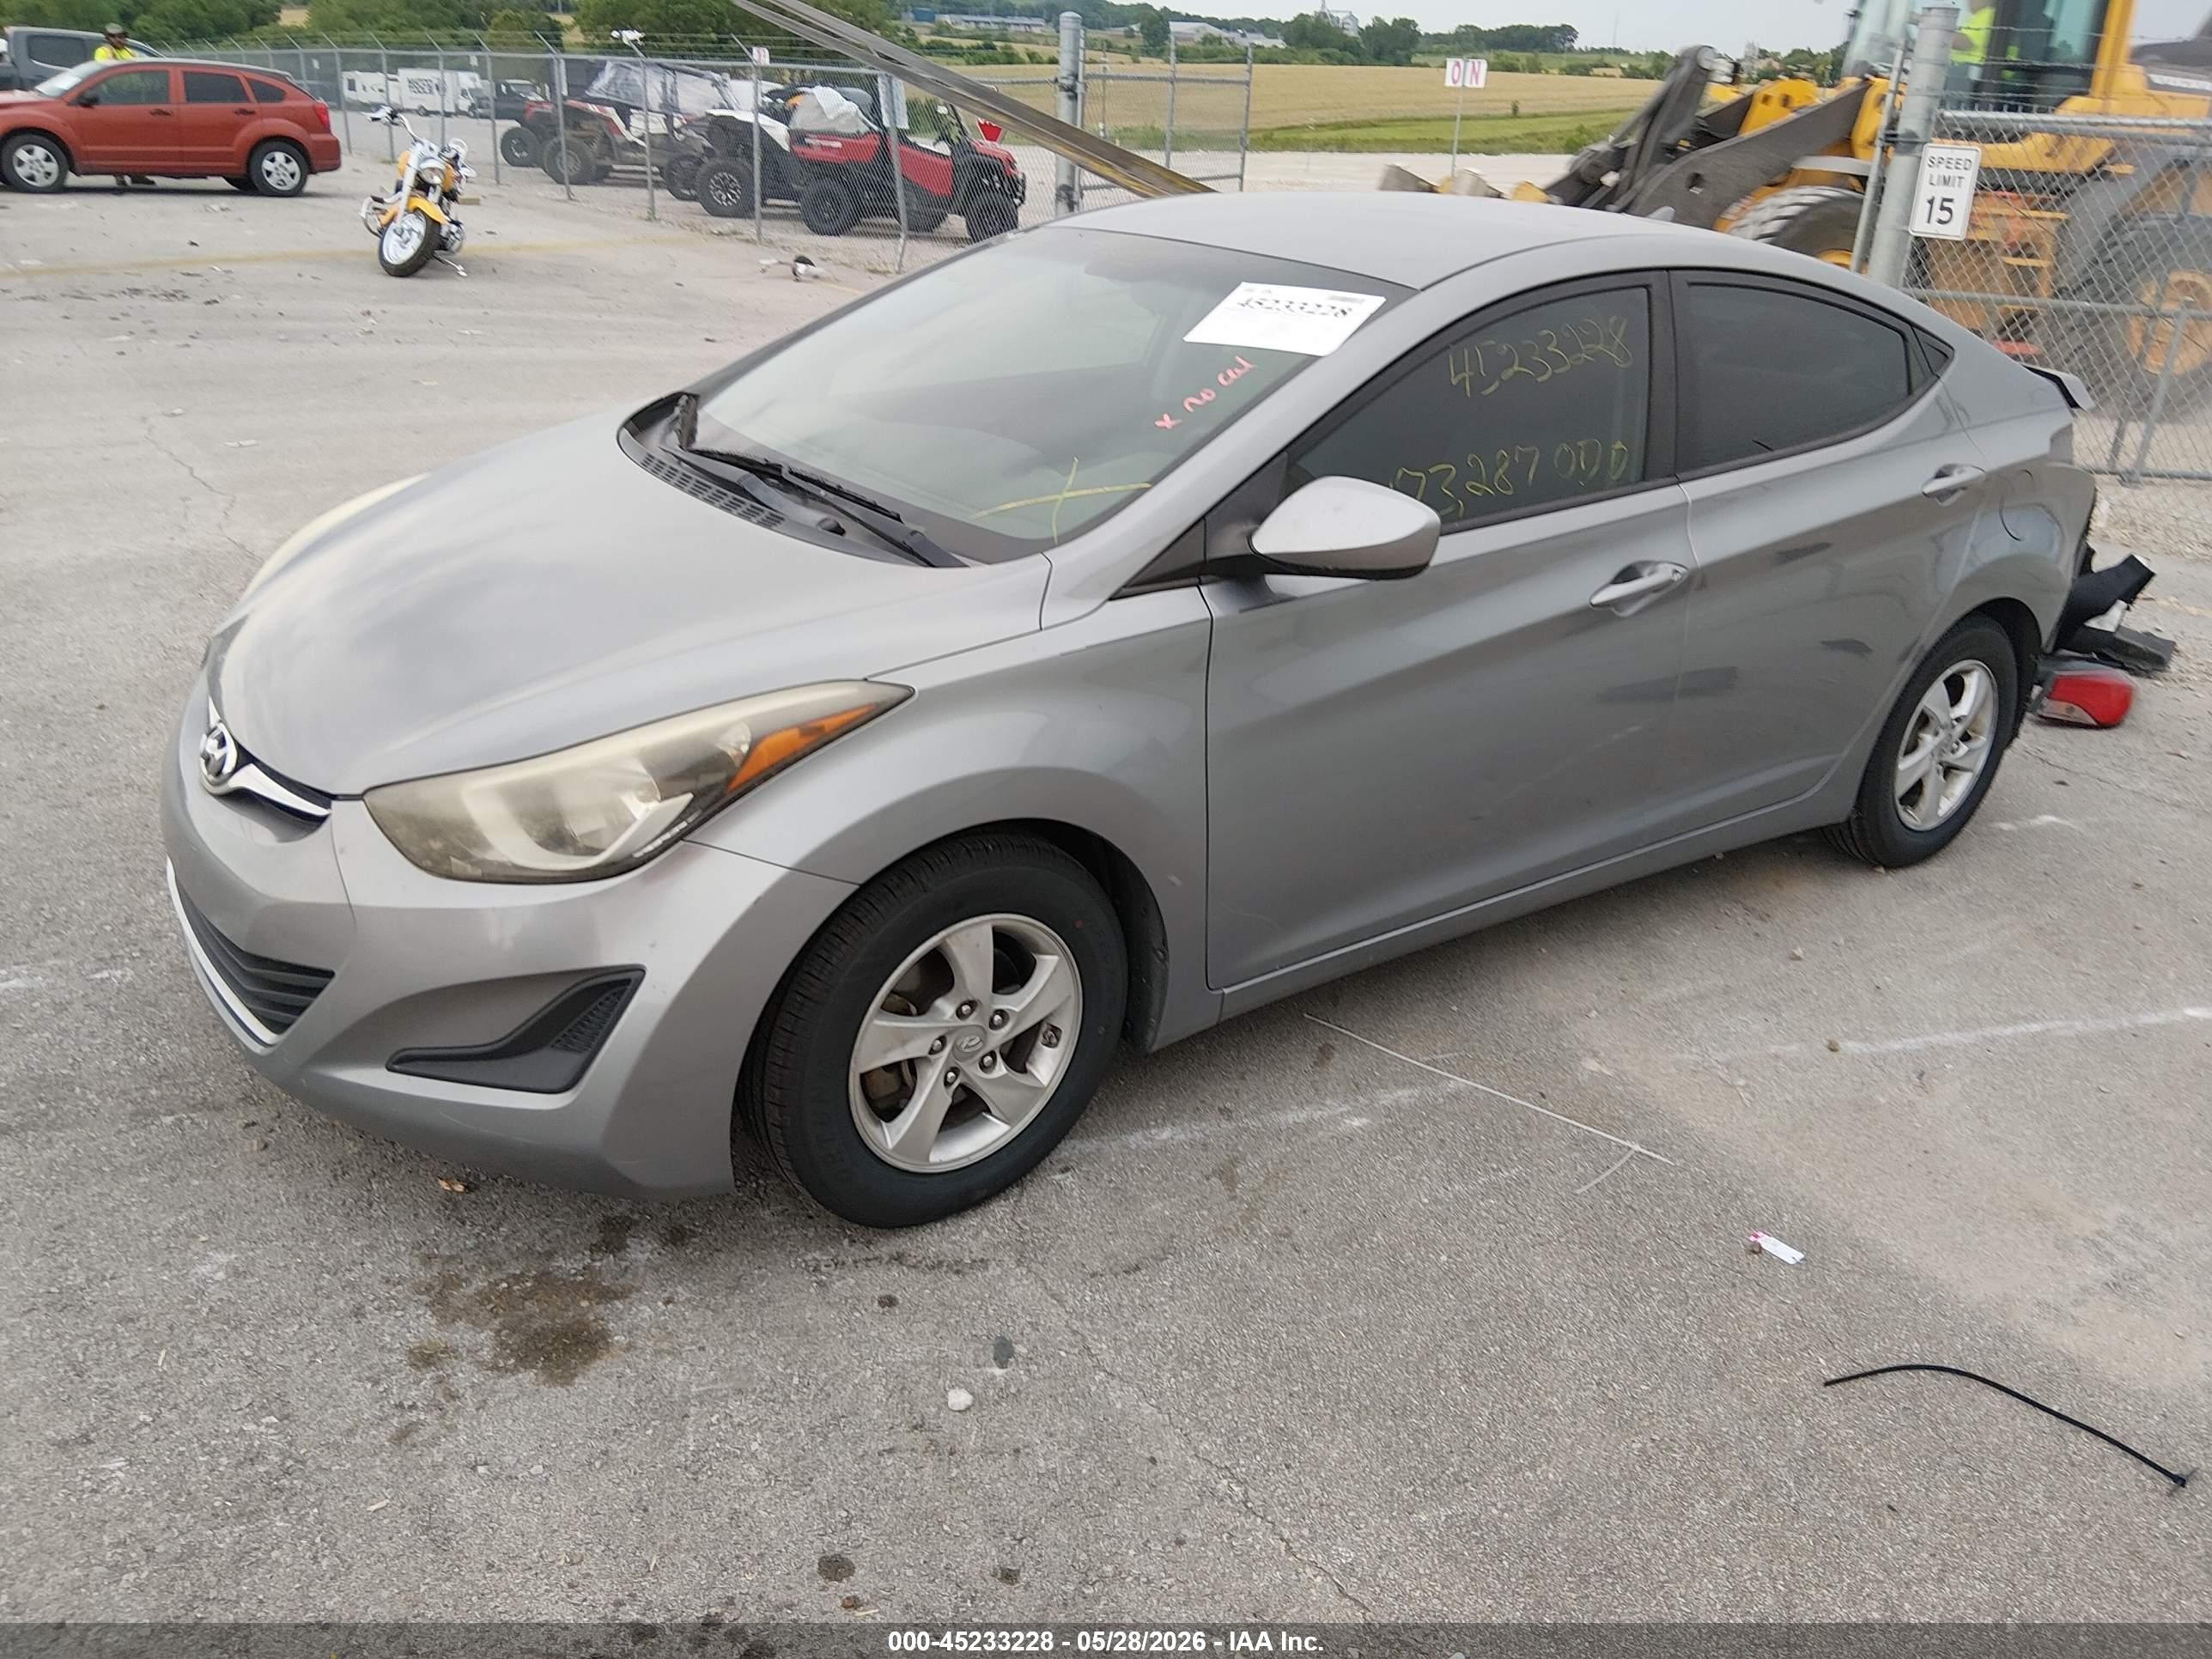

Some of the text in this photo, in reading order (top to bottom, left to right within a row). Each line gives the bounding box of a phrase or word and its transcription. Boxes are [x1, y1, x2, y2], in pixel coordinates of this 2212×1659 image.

[1927, 155, 1972, 171] SPEED
[1929, 173, 1965, 188] LIMIT
[1926, 195, 1954, 225] 15
